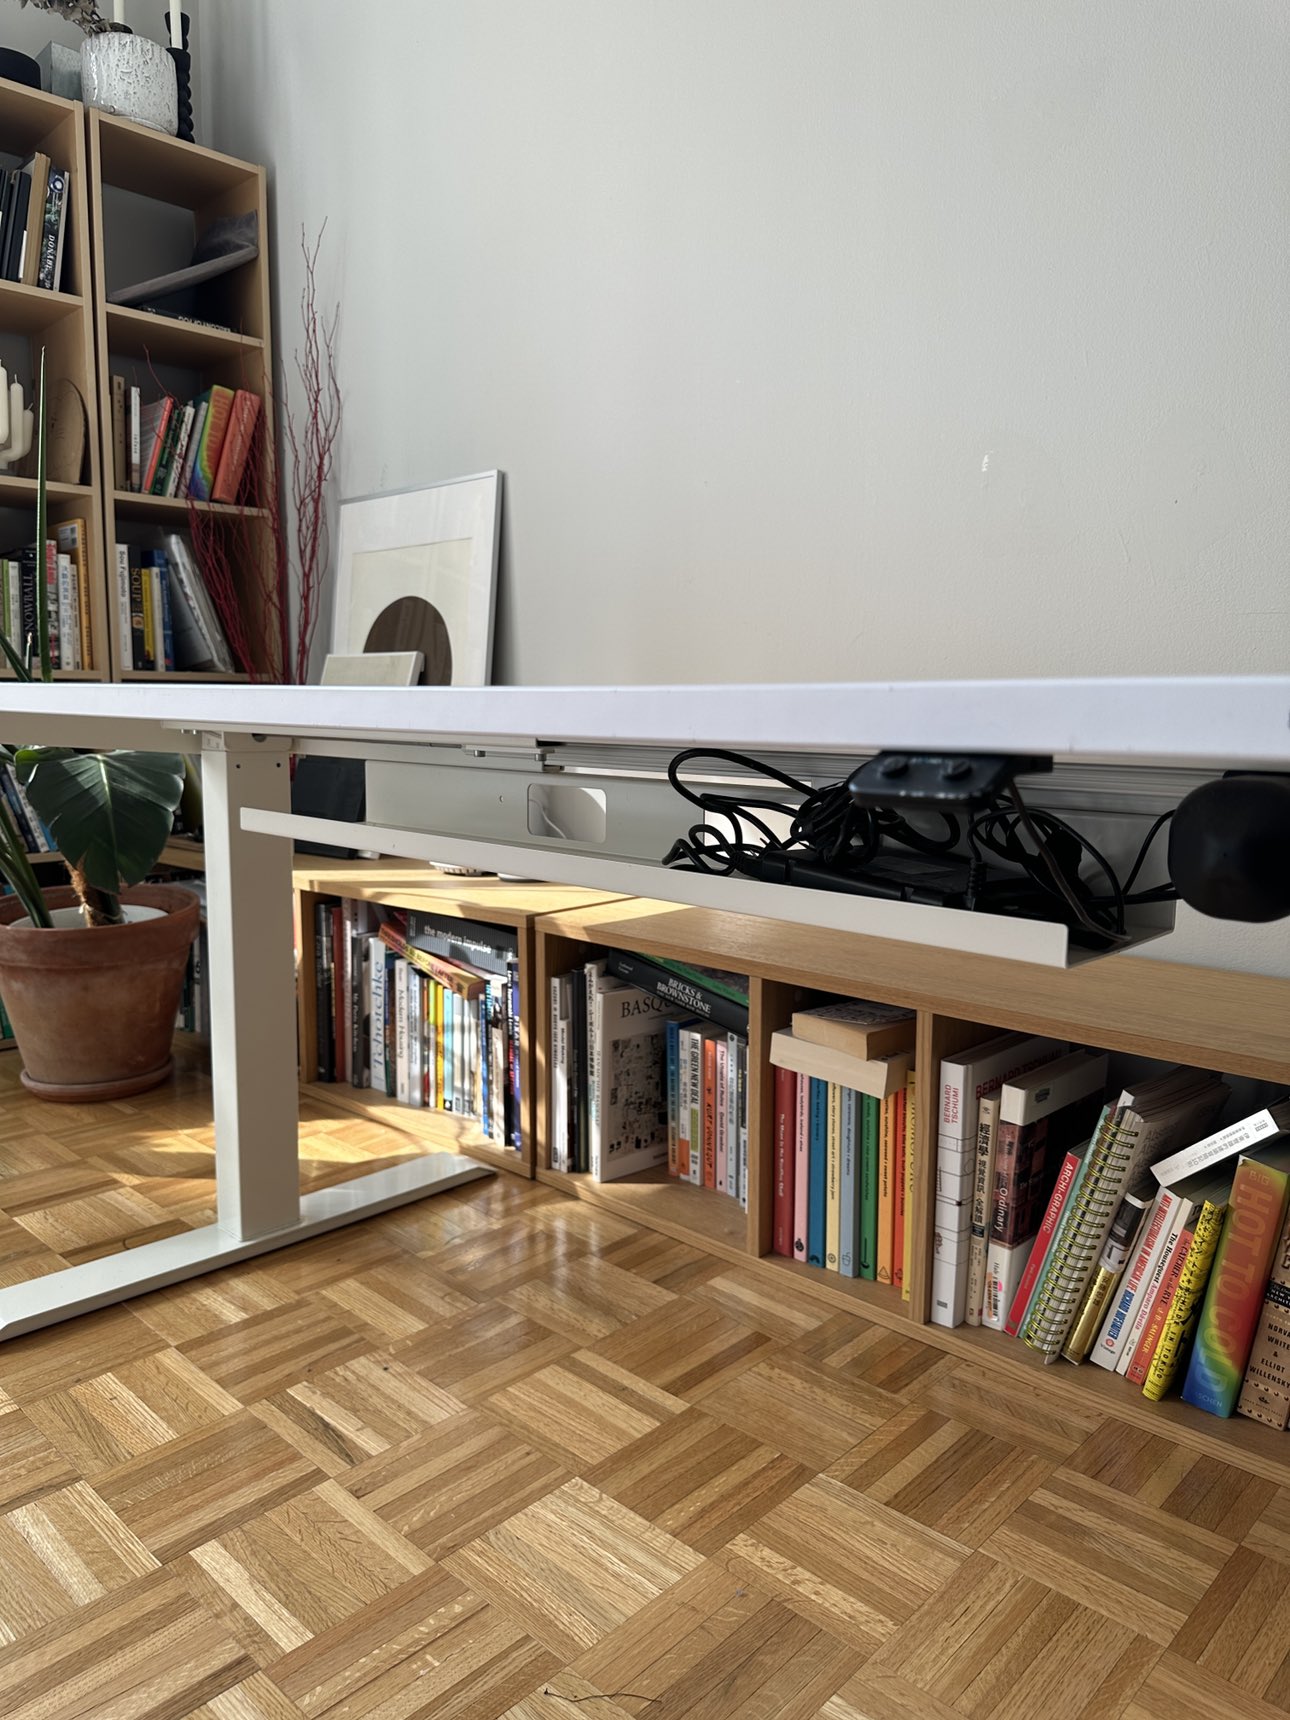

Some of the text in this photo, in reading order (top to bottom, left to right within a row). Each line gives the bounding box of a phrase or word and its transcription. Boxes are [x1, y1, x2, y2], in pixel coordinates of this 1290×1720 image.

[46, 235, 55, 271] DONABE
[131, 567, 141, 601] SOUP
[23, 574, 33, 633] NOWBALL
[424, 926, 436, 937] the
[437, 930, 462, 945] modern
[463, 936, 492, 954] impulse
[656, 981, 712, 1014] BROWNSTONE
[668, 978, 695, 998] BRICKS
[690, 1038, 699, 1050] THE
[690, 1051, 699, 1073] GREEN
[690, 1073, 699, 1088] NEW
[690, 1089, 698, 1105] DEAL
[944, 1084, 952, 1124] BERNARD
[951, 1087, 959, 1124] TSCHUMI
[1249, 1171, 1270, 1187] BIG
[994, 1187, 1009, 1233] Ordinary
[1043, 1161, 1074, 1234] ARCHI-GRAPHIC
[1169, 1233, 1178, 1246] The
[1153, 1246, 1174, 1284] Houseguest
[1171, 1244, 1190, 1278] CATCHER
[1143, 1283, 1158, 1309] Amparo
[1161, 1290, 1172, 1305] RYE
[1194, 1184, 1273, 1393] HOT TO COLD
[1142, 1323, 1158, 1354] SALINGER
[1156, 1299, 1187, 1379] MADE IN TOKYO
[1267, 1335, 1290, 1351] WHITE
[1249, 1365, 1290, 1389] WILLENSKY
[1261, 1358, 1285, 1373] ELLIOT
